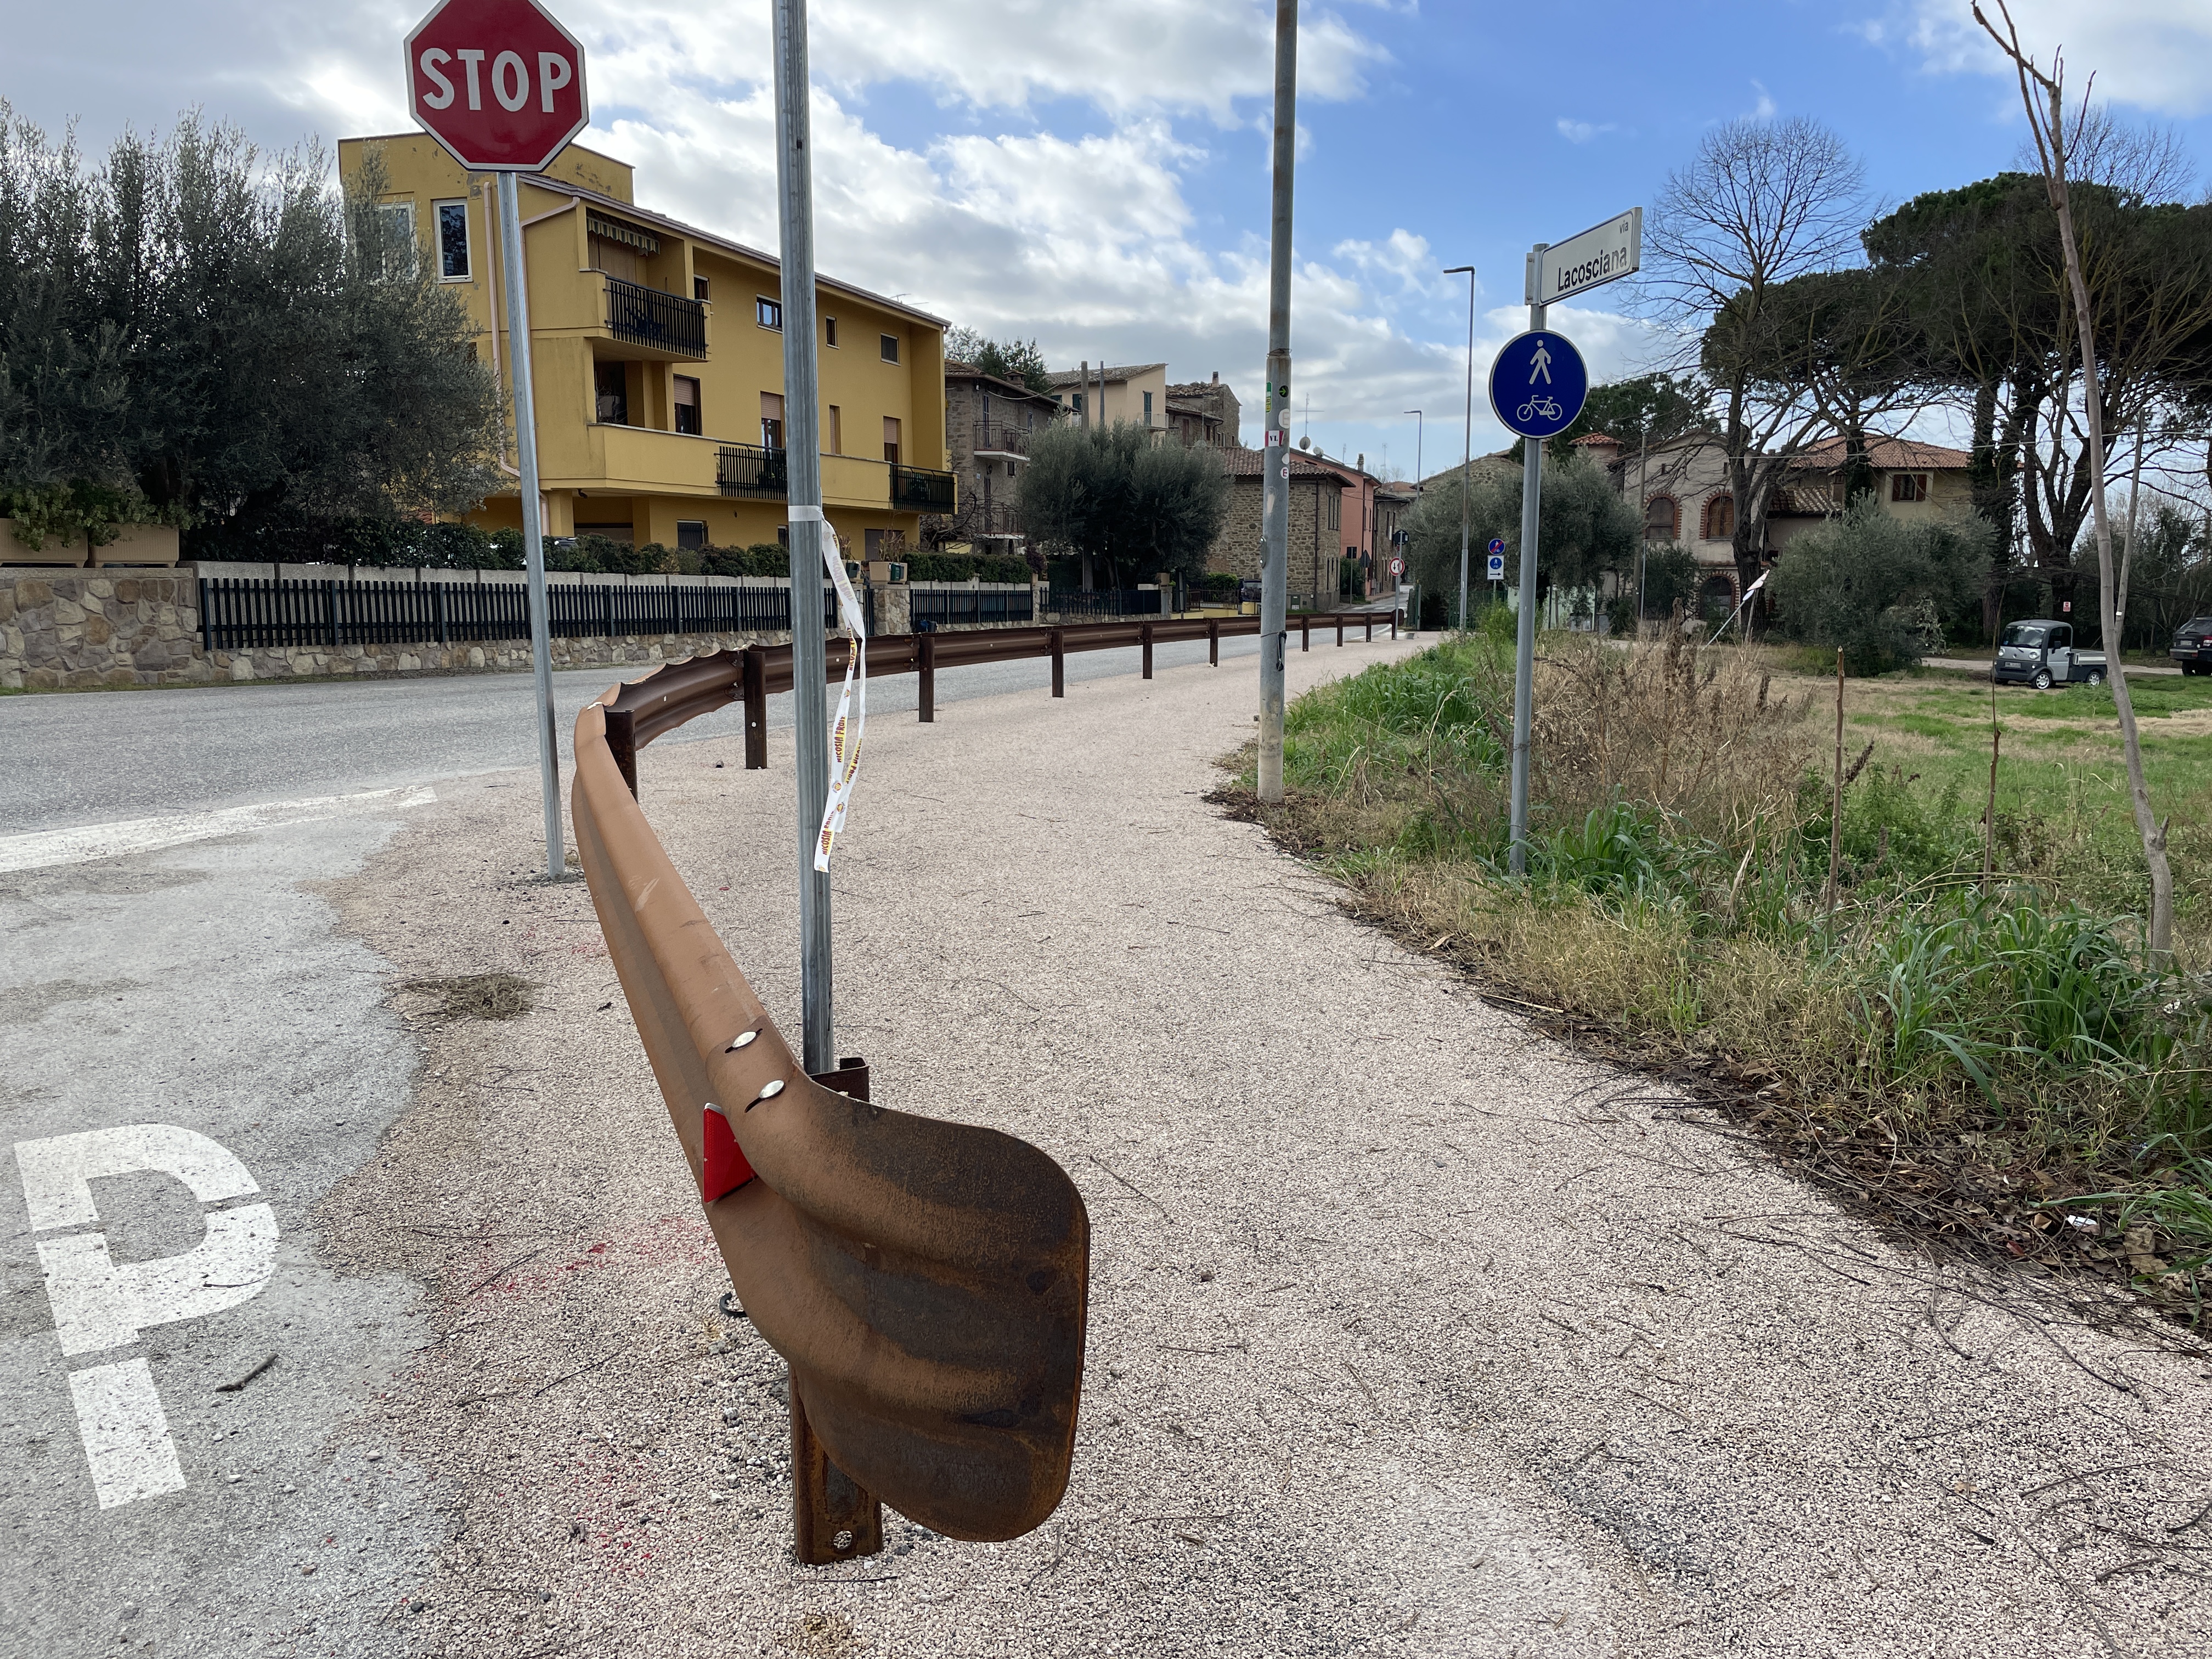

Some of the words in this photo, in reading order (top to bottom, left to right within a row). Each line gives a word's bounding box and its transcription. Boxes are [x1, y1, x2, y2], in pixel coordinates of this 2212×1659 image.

[420, 47, 572, 113] STOP
[1619, 219, 1629, 234] via
[1558, 247, 1627, 292] Lacosciana
[1283, 469, 1288, 477] E
[835, 716, 845, 735] FRUIT
[834, 736, 844, 763] NICOSIA
[821, 830, 832, 855] NICOSIA
[13, 1123, 280, 1510] P
